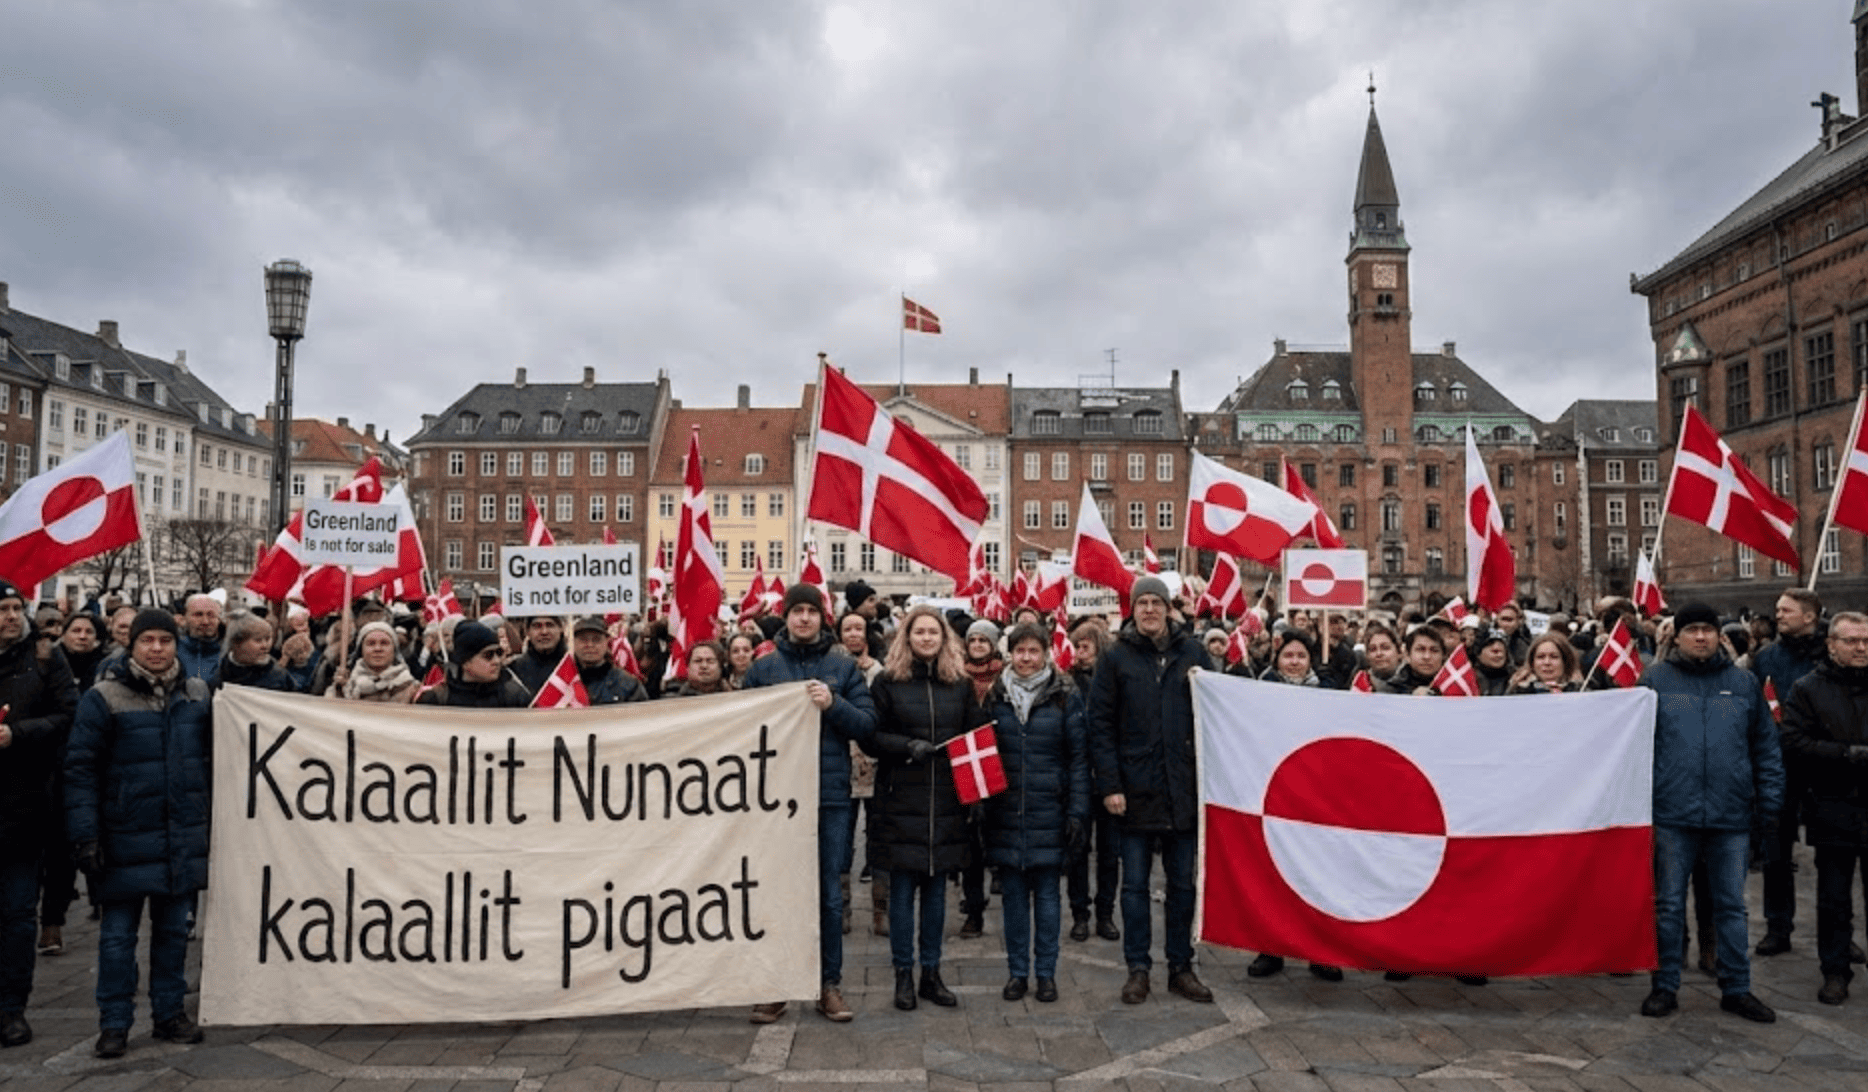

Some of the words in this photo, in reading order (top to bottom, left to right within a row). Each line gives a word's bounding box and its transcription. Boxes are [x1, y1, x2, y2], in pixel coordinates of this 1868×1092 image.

[306, 509, 397, 533] Greenland
[305, 537, 316, 551] is
[320, 538, 342, 552] not
[345, 537, 364, 553] for
[367, 539, 395, 554] sale
[508, 552, 632, 578] Greenland
[508, 587, 524, 606] is
[530, 588, 560, 605] not
[565, 586, 590, 604] for
[596, 585, 633, 603] sale
[246, 722, 527, 825] Kalaallit
[552, 724, 799, 823] Nunaat,
[258, 865, 524, 964] kalaallit
[561, 856, 766, 990] pigaat
